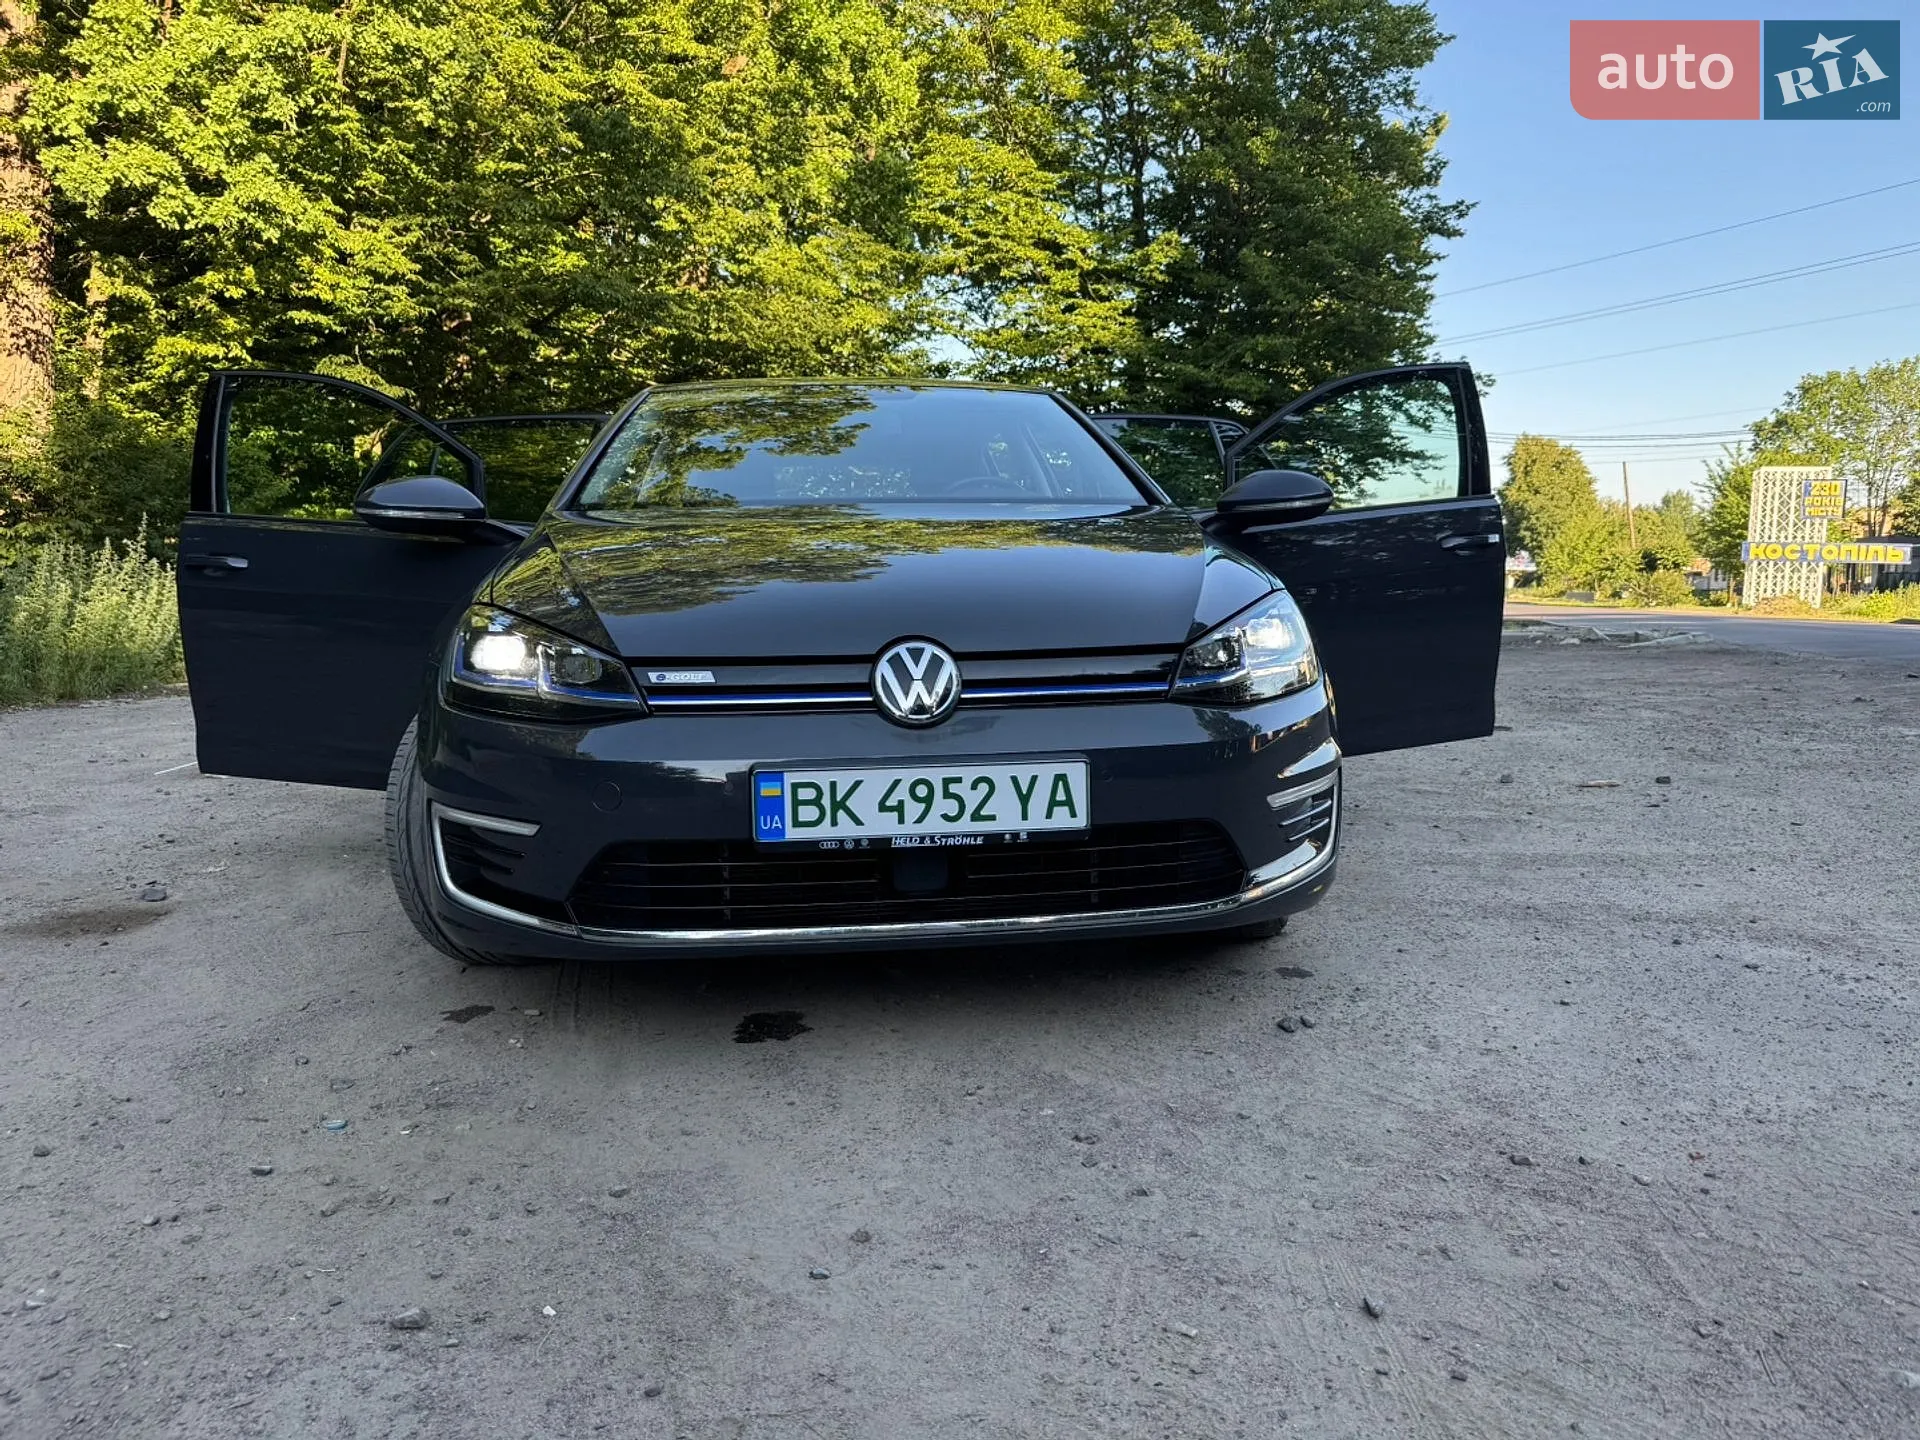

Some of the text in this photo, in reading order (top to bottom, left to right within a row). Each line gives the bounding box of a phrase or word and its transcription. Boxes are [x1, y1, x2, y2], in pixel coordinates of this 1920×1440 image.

[1811, 481, 1841, 496] 230
[879, 643, 953, 719] VW
[790, 773, 1077, 829] BK 4952 YA
[760, 815, 783, 830] UA
